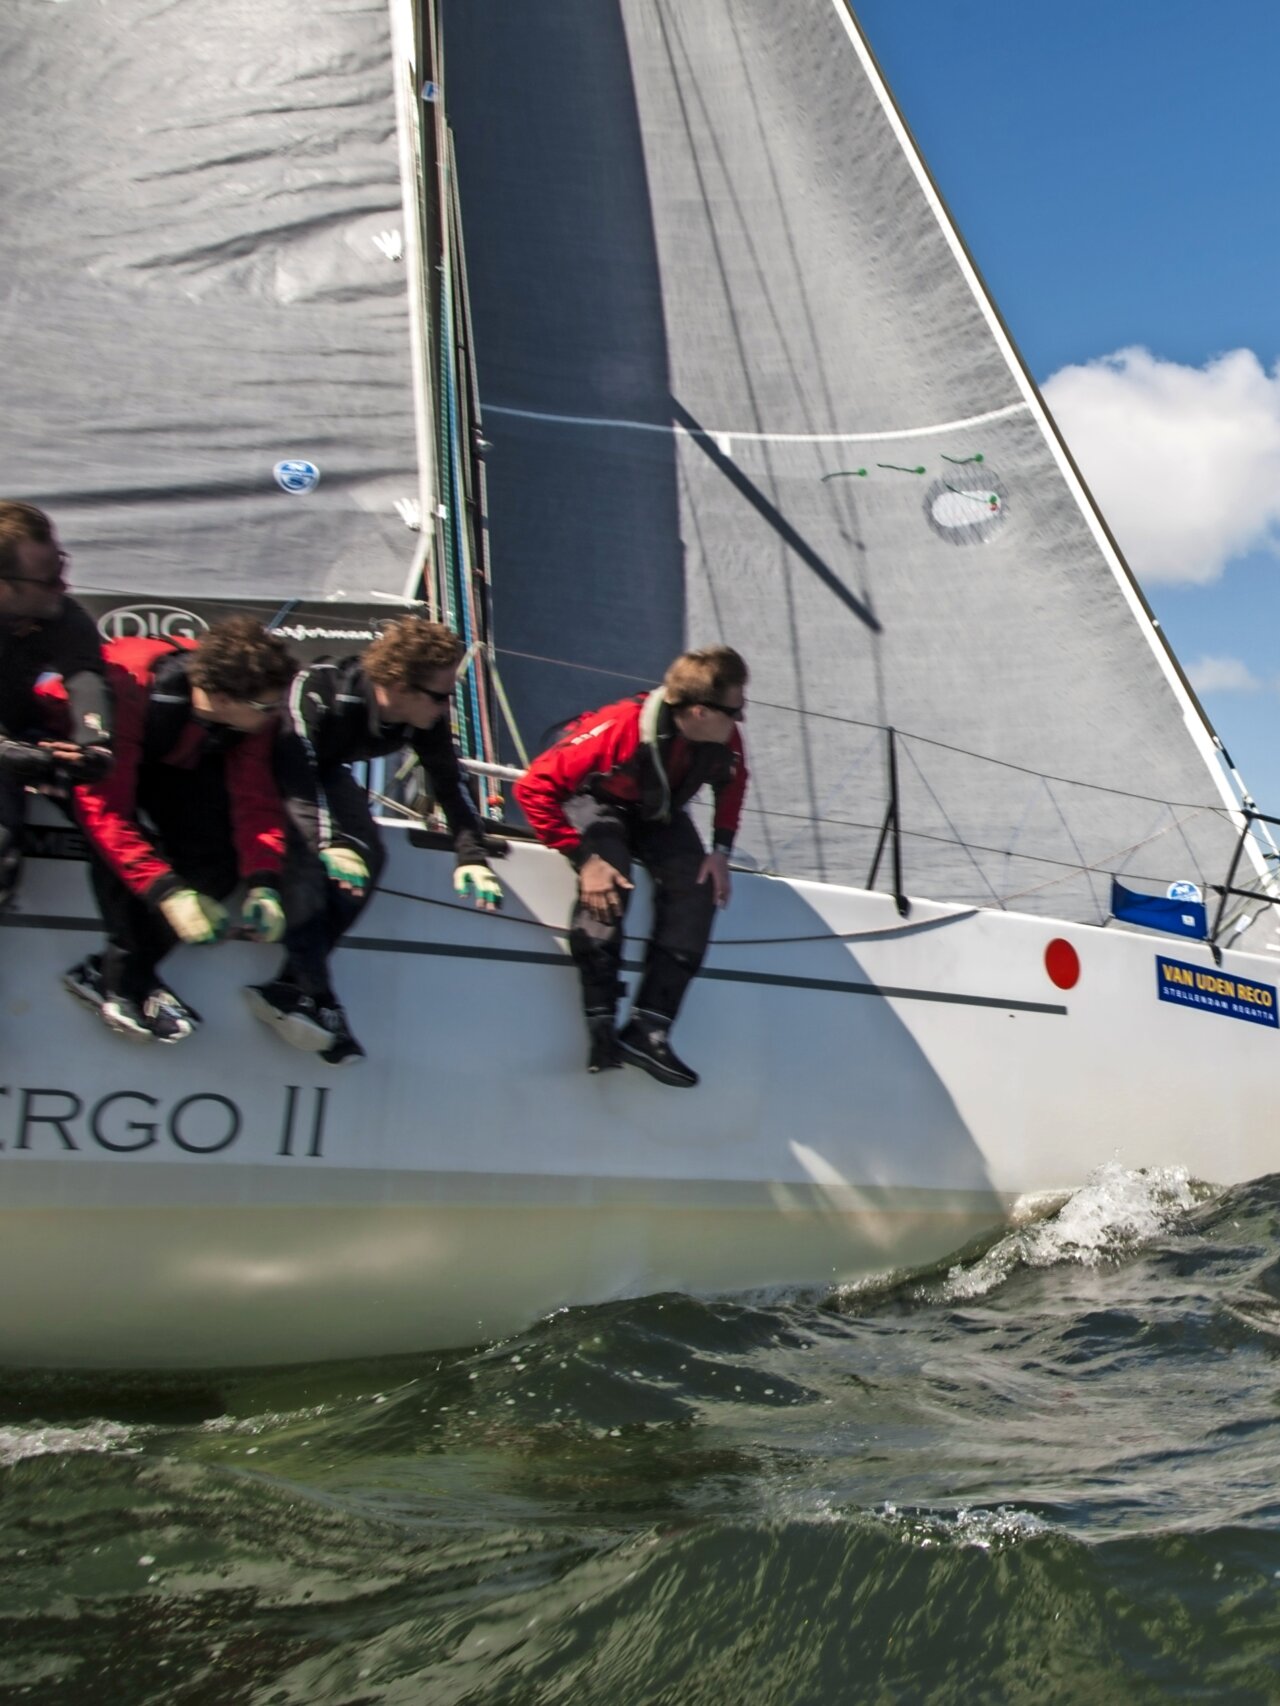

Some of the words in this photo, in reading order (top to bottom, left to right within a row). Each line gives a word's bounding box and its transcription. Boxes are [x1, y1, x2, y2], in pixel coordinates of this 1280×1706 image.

[1161, 963, 1193, 988] VAN
[1196, 972, 1235, 998] UDEN
[1238, 983, 1273, 1008] RECO
[1163, 986, 1229, 1010] STELLENDAM
[1232, 1003, 1275, 1021] REGATTA
[0, 1086, 243, 1155] RGO
[277, 1085, 331, 1158] II
